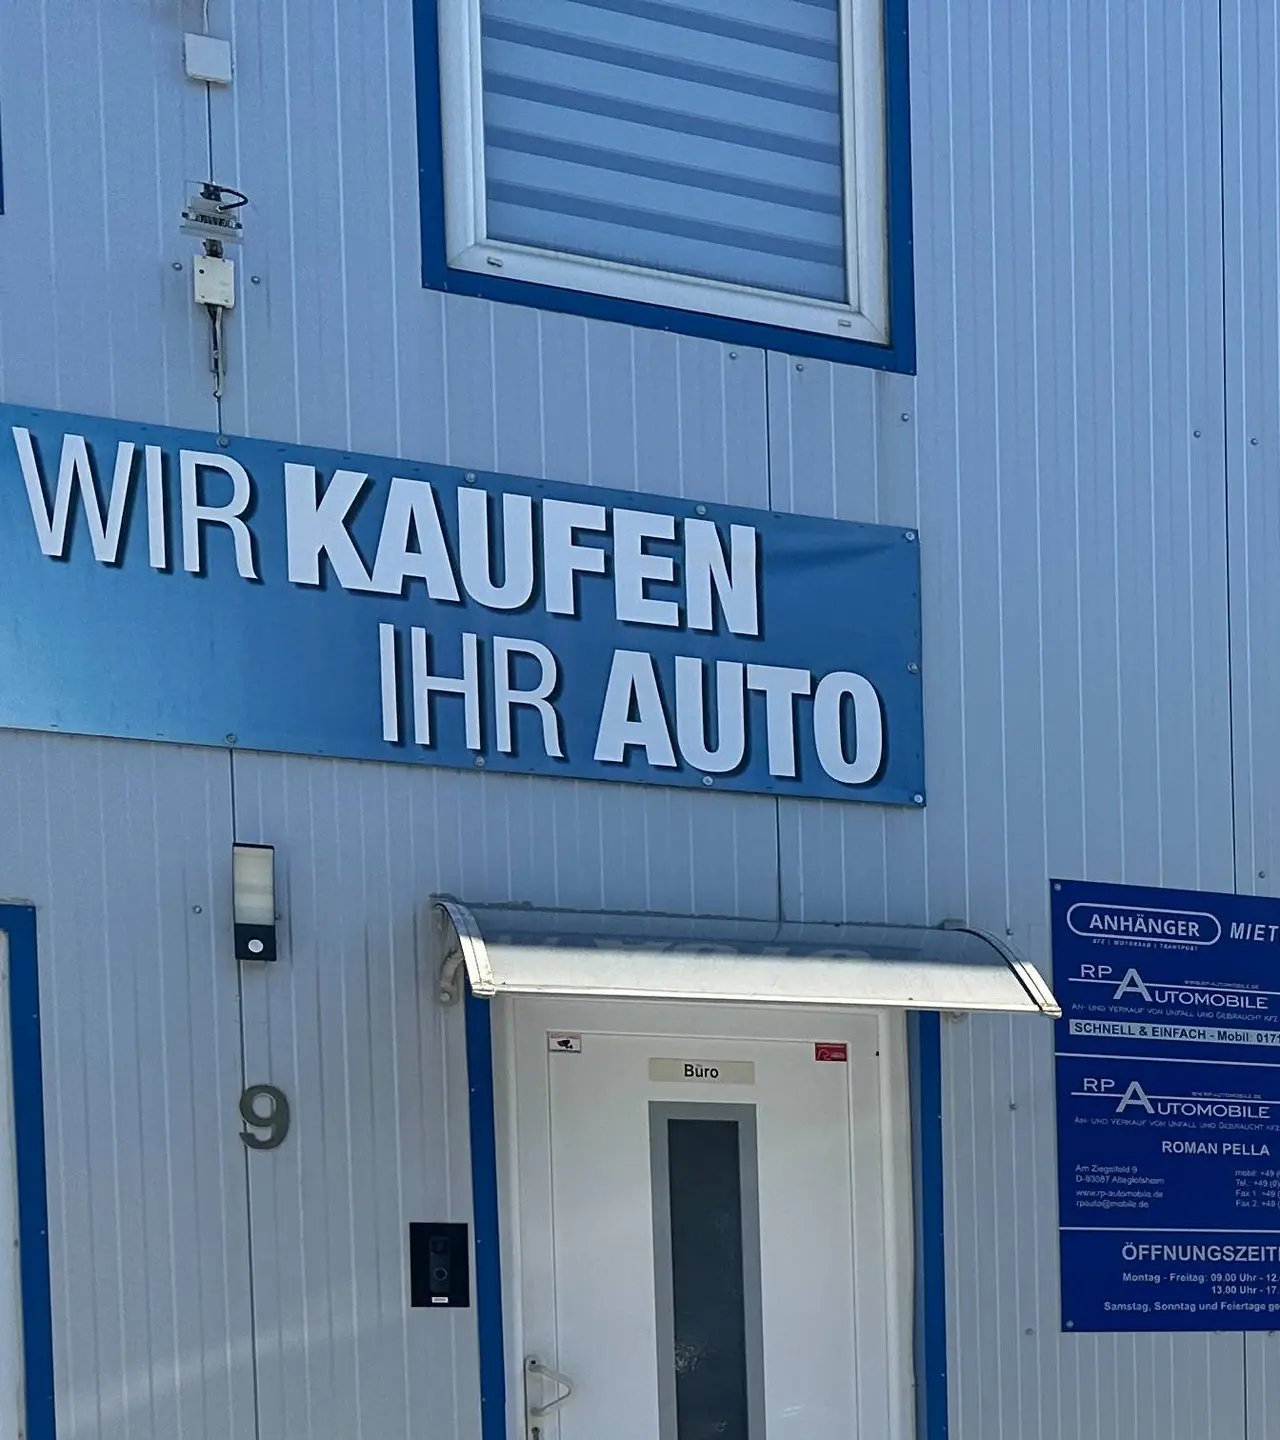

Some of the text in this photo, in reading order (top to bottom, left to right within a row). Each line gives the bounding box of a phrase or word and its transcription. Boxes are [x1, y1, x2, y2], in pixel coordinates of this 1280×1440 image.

[13, 427, 760, 636] WIR KAUFEN
[379, 623, 883, 785] IHR AUTO
[1089, 913, 1200, 937] ANHÄNGER
[1081, 964, 1112, 978] RP
[1113, 968, 1268, 1010] AUTOMOBILE
[1108, 1005, 1143, 1014] VERKAUF
[1074, 1022, 1135, 1036] SCHNELL
[1138, 1027, 1148, 1036] &
[1151, 1027, 1206, 1040] EINFACH
[684, 1062, 719, 1079] Büro
[1083, 1078, 1115, 1092] RP
[1115, 1081, 1270, 1119] AUTOMOBILE
[239, 1084, 290, 1150] 9
[1161, 1141, 1270, 1156] ROMAN PELLA
[1122, 1272, 1161, 1284] Montag
[1170, 1272, 1207, 1284] Freitag:
[1210, 1273, 1236, 1282] 09.00
[1239, 1273, 1257, 1282] Uhr
[1211, 1285, 1236, 1295] 13.00
[1239, 1285, 1257, 1294] Uhr
[1103, 1301, 1151, 1313] Samstag,
[1154, 1301, 1196, 1313] Sonntag
[1198, 1301, 1218, 1311] und
[1220, 1302, 1266, 1312] Feiertage
